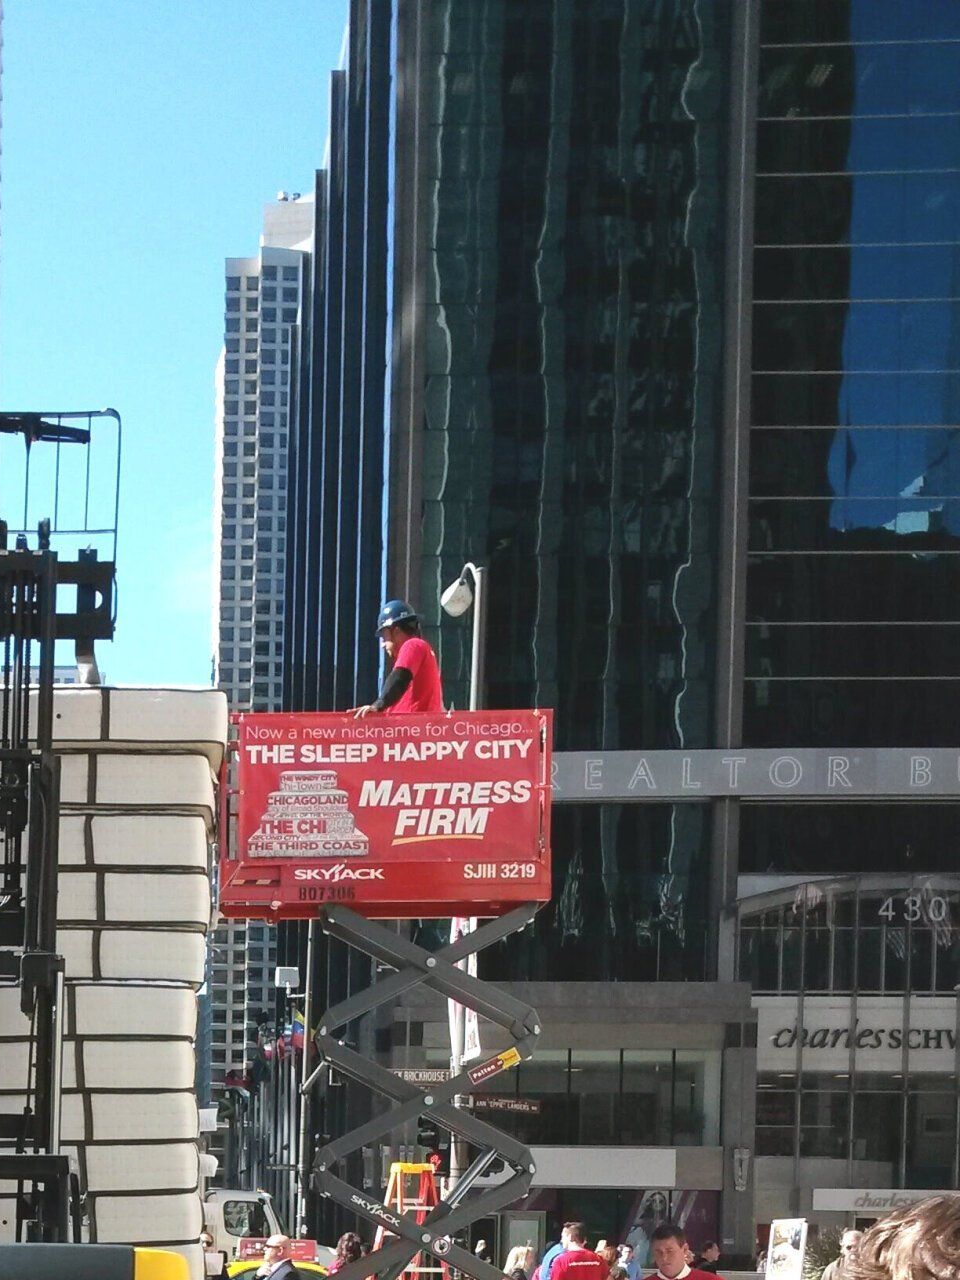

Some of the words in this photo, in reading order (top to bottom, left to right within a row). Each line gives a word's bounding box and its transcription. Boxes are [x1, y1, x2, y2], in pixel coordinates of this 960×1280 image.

[246, 725, 283, 740] Now
[288, 728, 298, 739] a
[302, 727, 337, 739] new
[341, 722, 421, 740] nickname
[425, 721, 448, 737] for
[453, 720, 534, 740] Chicago...
[245, 744, 295, 765] THE
[300, 743, 377, 763] SLEEP
[383, 740, 470, 762] HAPPY
[474, 738, 533, 759] CITY
[267, 795, 349, 806] CHICAGOLAND
[359, 779, 532, 807] MATTRESS
[260, 819, 294, 835] THE
[297, 819, 327, 835] CHI
[395, 807, 492, 836] FIRM
[248, 841, 274, 851] THE
[276, 841, 319, 851] THIRD
[322, 840, 369, 851] COAST
[294, 863, 385, 882] SKYJACK
[500, 863, 536, 878] 3219
[878, 896, 947, 922] 430
[403, 1070, 445, 1082] BRICKHOUSE
[350, 1194, 401, 1227] SKYJACK
